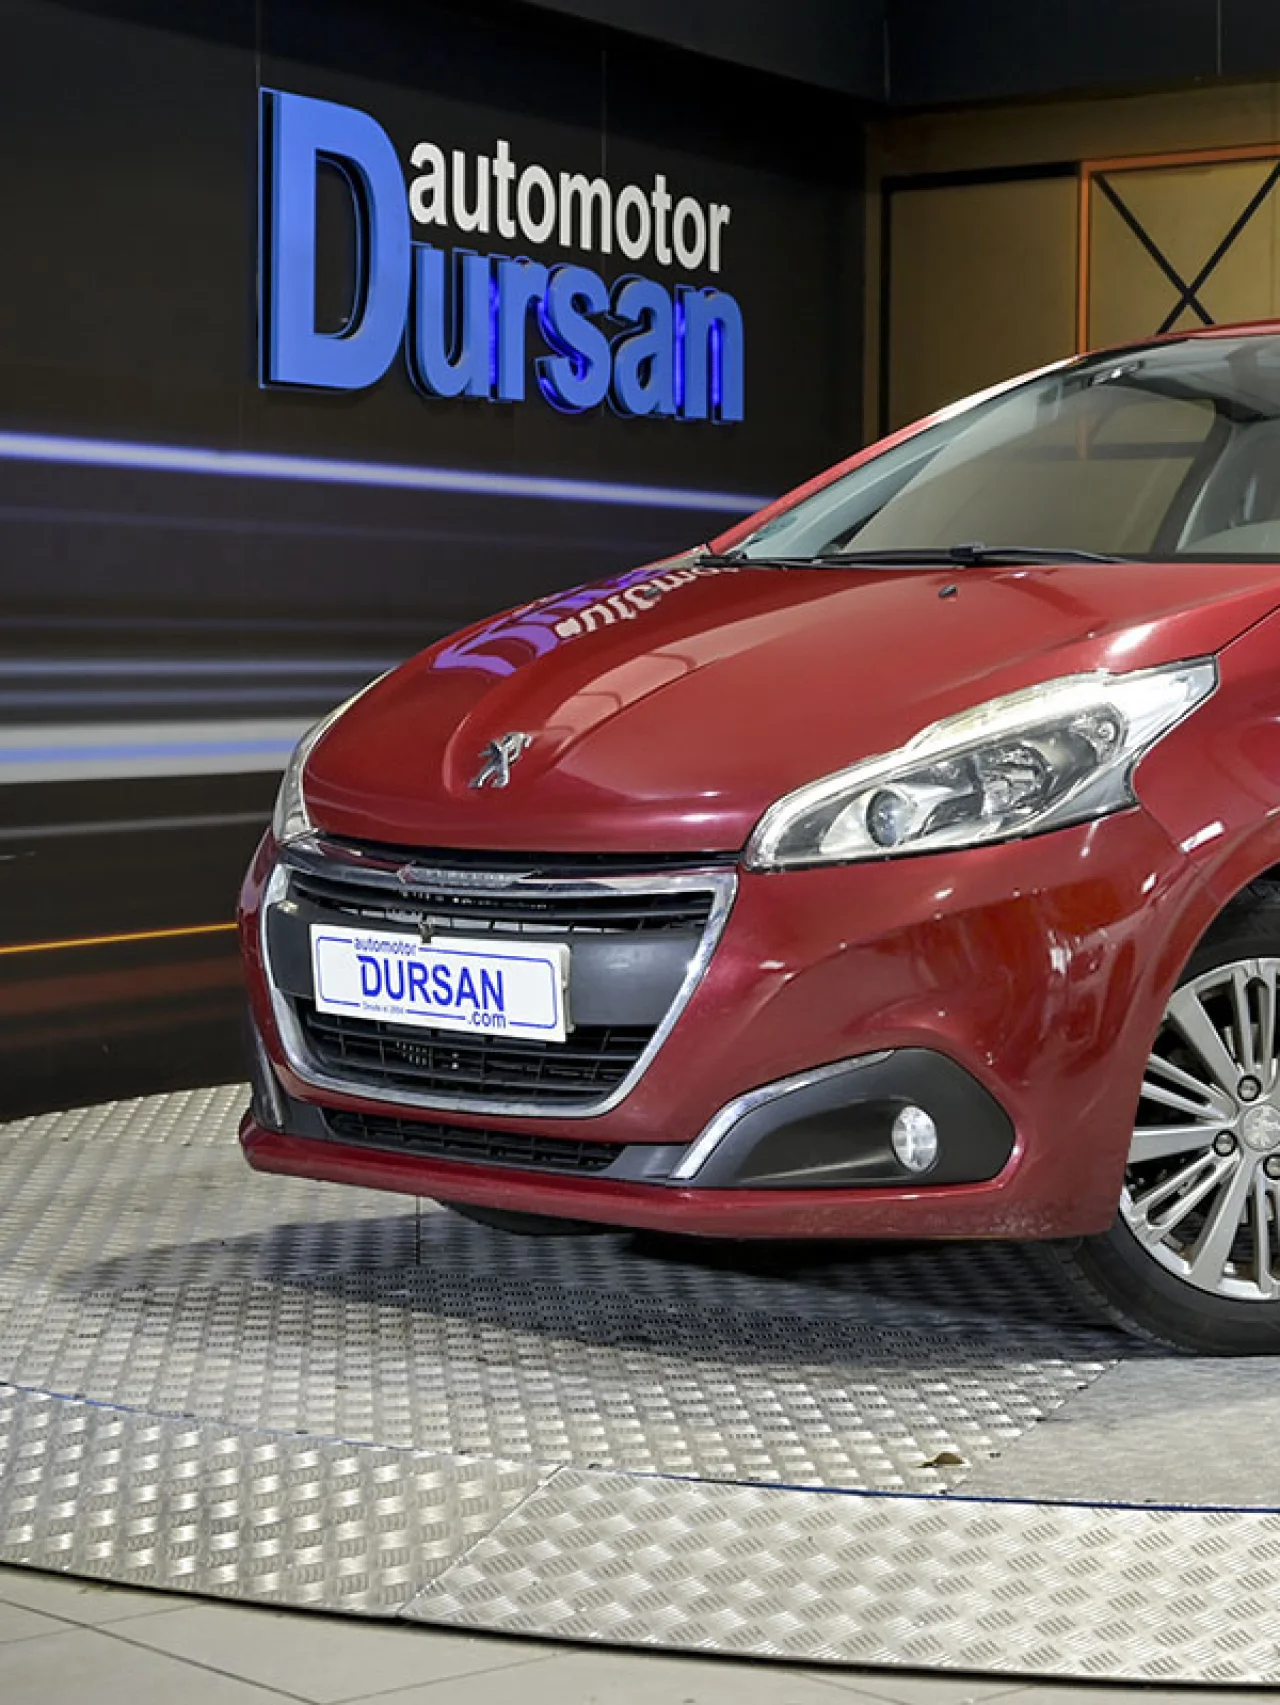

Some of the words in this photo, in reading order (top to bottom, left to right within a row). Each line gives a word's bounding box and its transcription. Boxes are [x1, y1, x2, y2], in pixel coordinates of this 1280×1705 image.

[408, 138, 731, 273] automotor
[258, 86, 745, 424] Dursan
[353, 936, 418, 957] automotor
[356, 953, 506, 1013] DURSAN
[466, 1010, 507, 1029] .com
